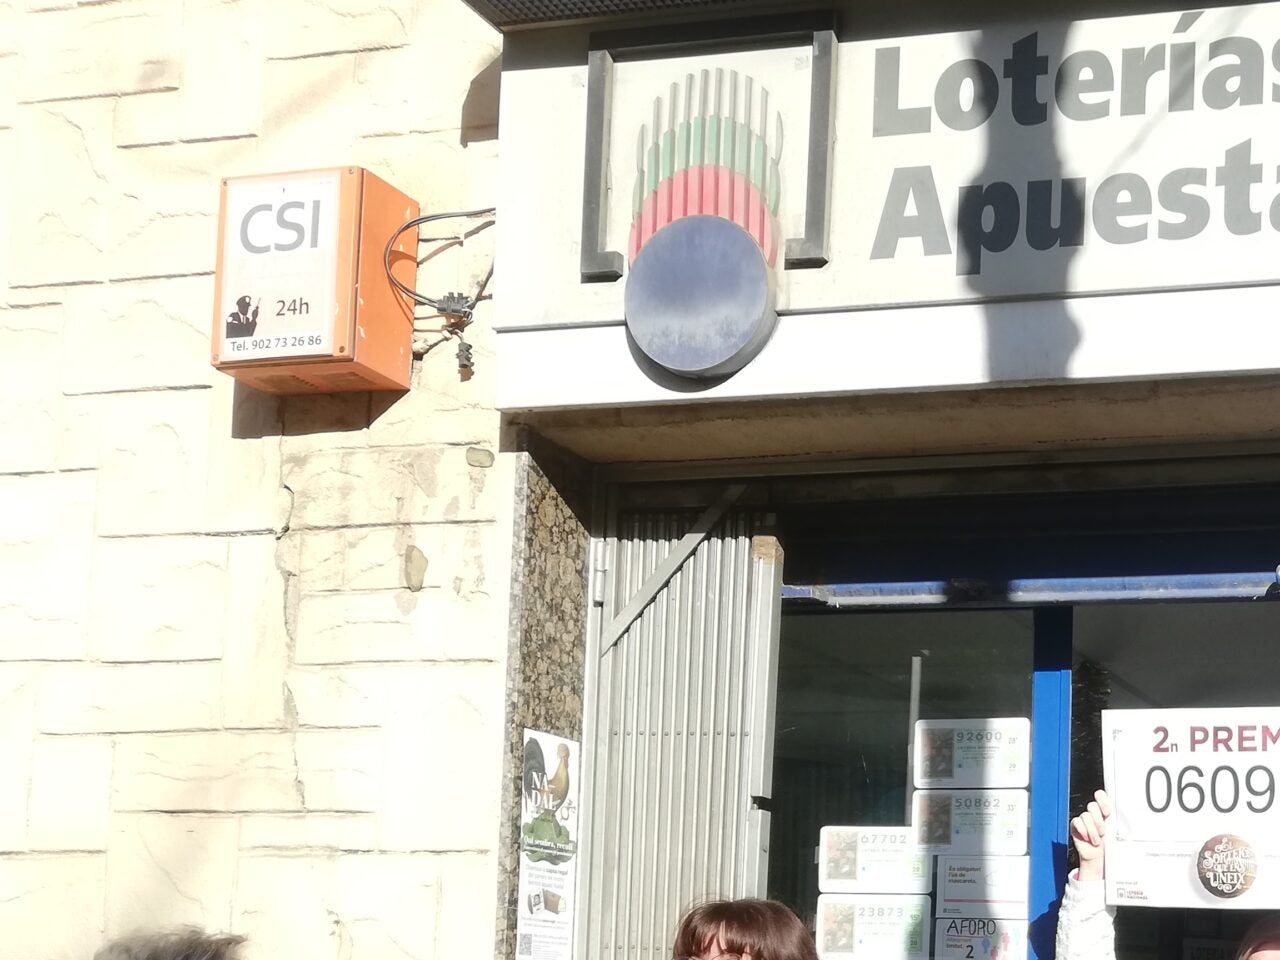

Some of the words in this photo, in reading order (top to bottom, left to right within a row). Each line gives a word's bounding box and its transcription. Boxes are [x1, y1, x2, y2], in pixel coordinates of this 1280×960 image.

[240, 200, 320, 254] CSI
[276, 298, 309, 316] 24h
[231, 341, 248, 351] Tel.
[252, 338, 271, 350] 902
[275, 338, 287, 347] 73
[292, 337, 304, 346] 26
[308, 335, 322, 345] 86
[956, 731, 1003, 742] 92600
[955, 797, 1001, 808] 50862
[860, 834, 906, 844] 67702
[1206, 871, 1246, 890] UNEIX
[858, 907, 904, 917] 23873
[946, 919, 996, 935] AFORO
[965, 944, 974, 958] 2
